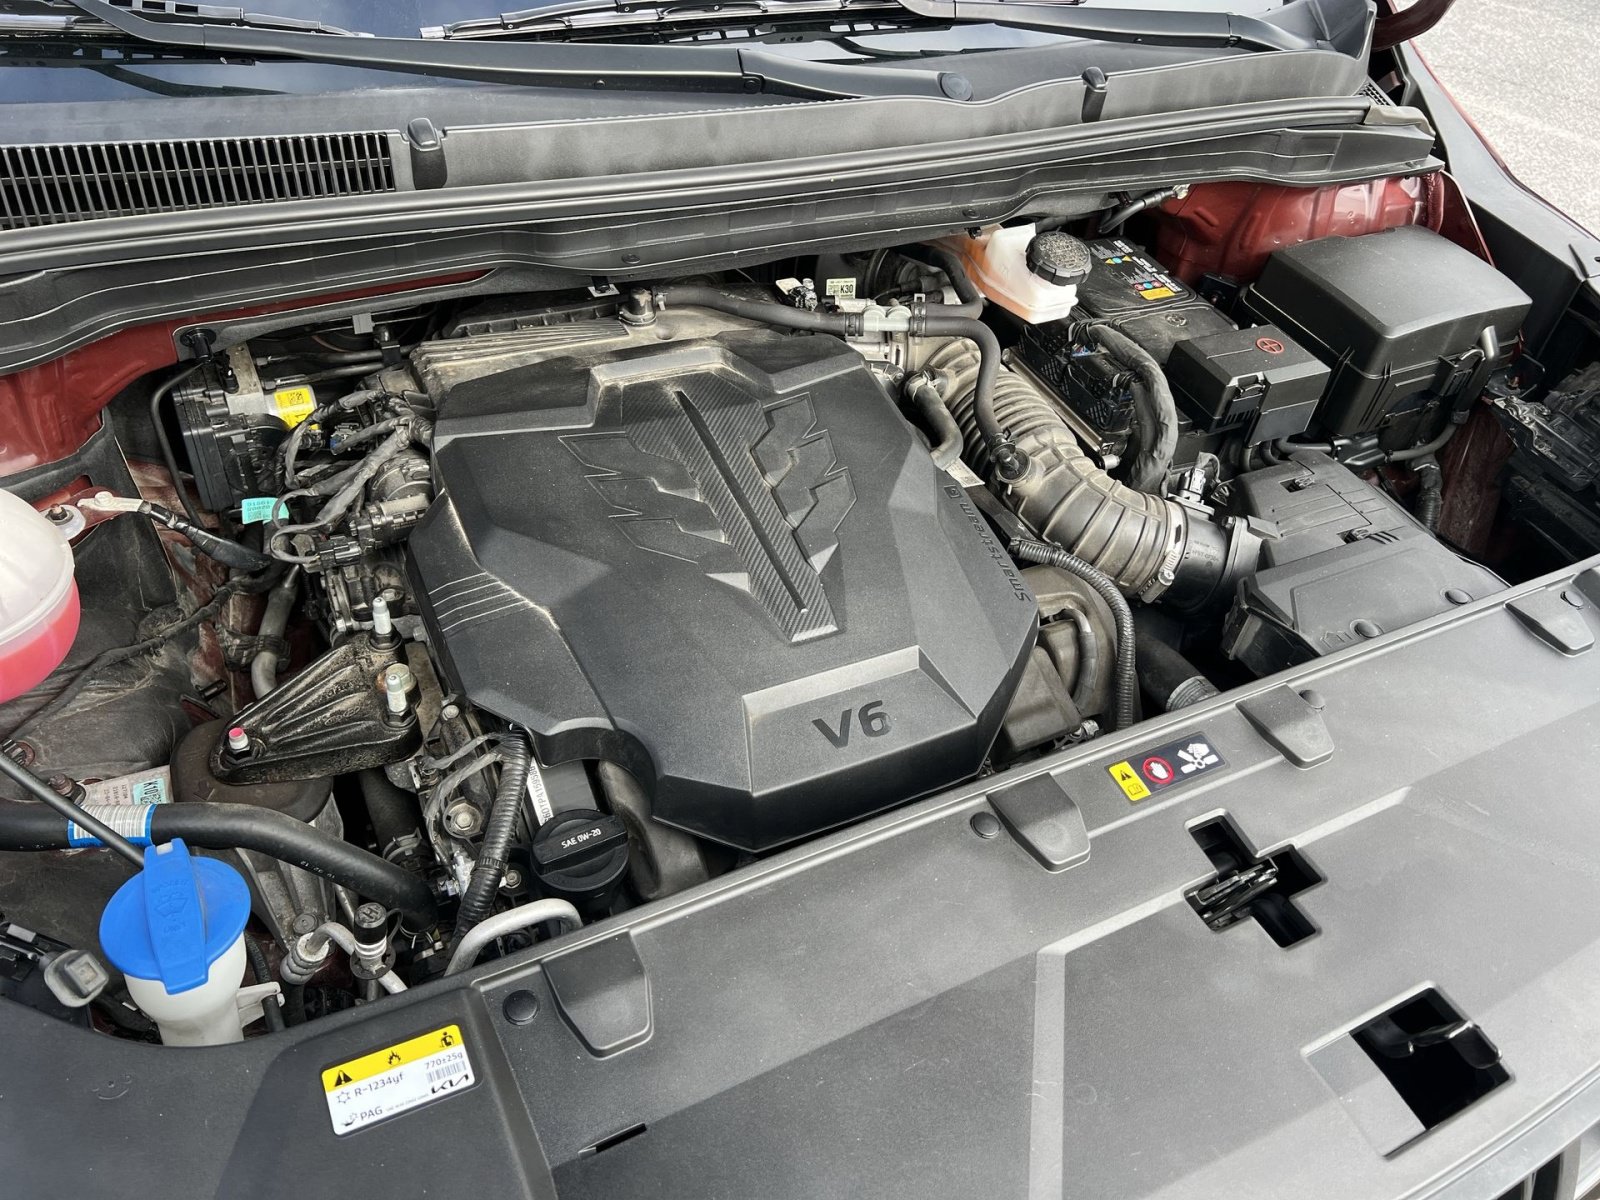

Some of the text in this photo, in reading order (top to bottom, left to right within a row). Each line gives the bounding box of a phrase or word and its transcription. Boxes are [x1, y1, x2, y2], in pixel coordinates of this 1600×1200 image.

[840, 284, 854, 294] K30
[960, 502, 1031, 602] Smartstream
[811, 699, 892, 749] V6
[561, 828, 602, 849] SAE 0W-20
[424, 1052, 463, 1069] 770±25g
[354, 1072, 404, 1097] R-1234yf
[360, 1106, 383, 1120] PAG
